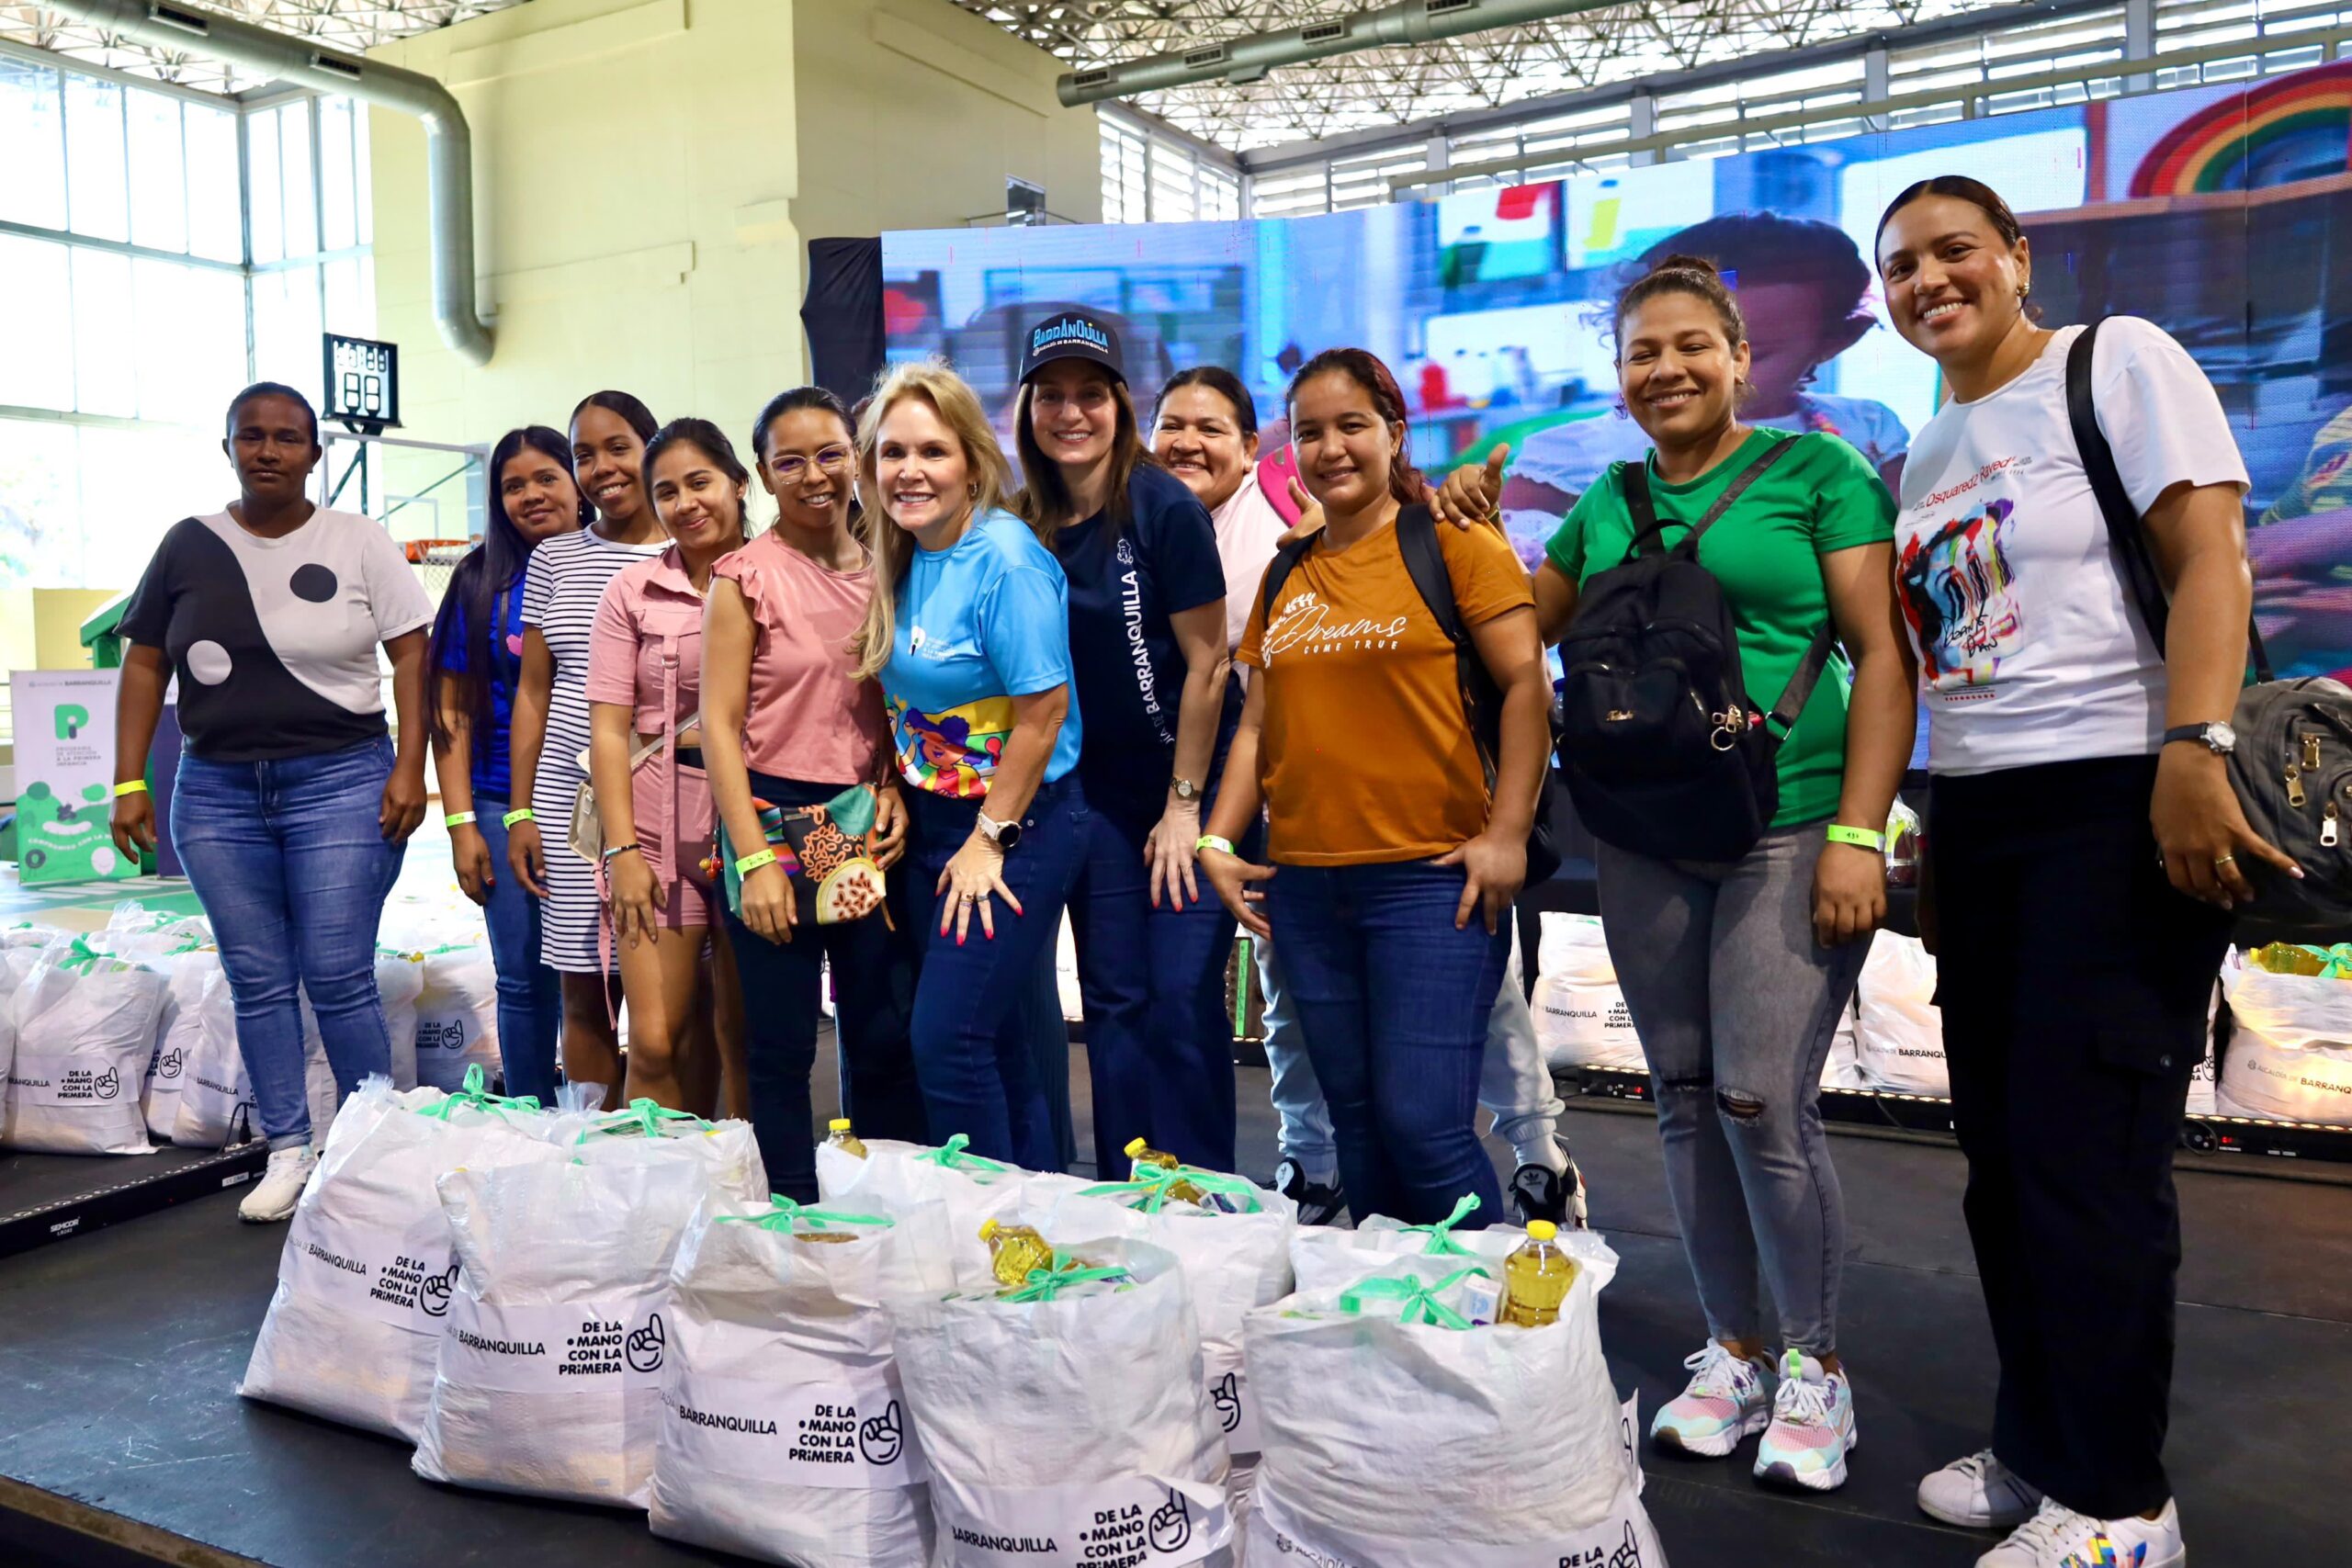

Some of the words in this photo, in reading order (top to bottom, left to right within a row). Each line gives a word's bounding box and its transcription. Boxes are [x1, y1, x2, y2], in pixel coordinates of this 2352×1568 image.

[1271, 604, 1407, 653] Dreams
[1121, 570, 1160, 715] BARRANQUILLA
[1304, 642, 1341, 654] COME
[1354, 640, 1397, 649] TRUE
[2301, 1077, 2352, 1094] BARRANQ
[51, 1219, 79, 1232] SEMCOR
[309, 1244, 367, 1275] BARRANQUILLA
[395, 1256, 410, 1268] DE
[411, 1259, 425, 1271] LA
[388, 1267, 422, 1283] MANO
[379, 1278, 402, 1292] CON
[404, 1286, 418, 1296] LA
[582, 1322, 600, 1333] DE
[605, 1321, 623, 1332] LA
[458, 1330, 546, 1355] BARRANQUILLA
[577, 1334, 623, 1347] MANO
[568, 1350, 600, 1361] CON
[604, 1348, 622, 1359] LA
[680, 1404, 777, 1435] BARRANQUILLA
[815, 1404, 833, 1417] DE
[837, 1406, 856, 1418] LA
[808, 1421, 856, 1433] MANO
[799, 1434, 831, 1447] CON
[836, 1436, 855, 1448] LA
[1094, 1510, 1116, 1525] DE
[1121, 1504, 1142, 1517] LA
[1091, 1519, 1145, 1541] MANO
[1084, 1543, 1122, 1559] CON
[1126, 1536, 1147, 1554] LA
[1559, 1554, 1580, 1568] DE
[1585, 1546, 1604, 1563] LA
